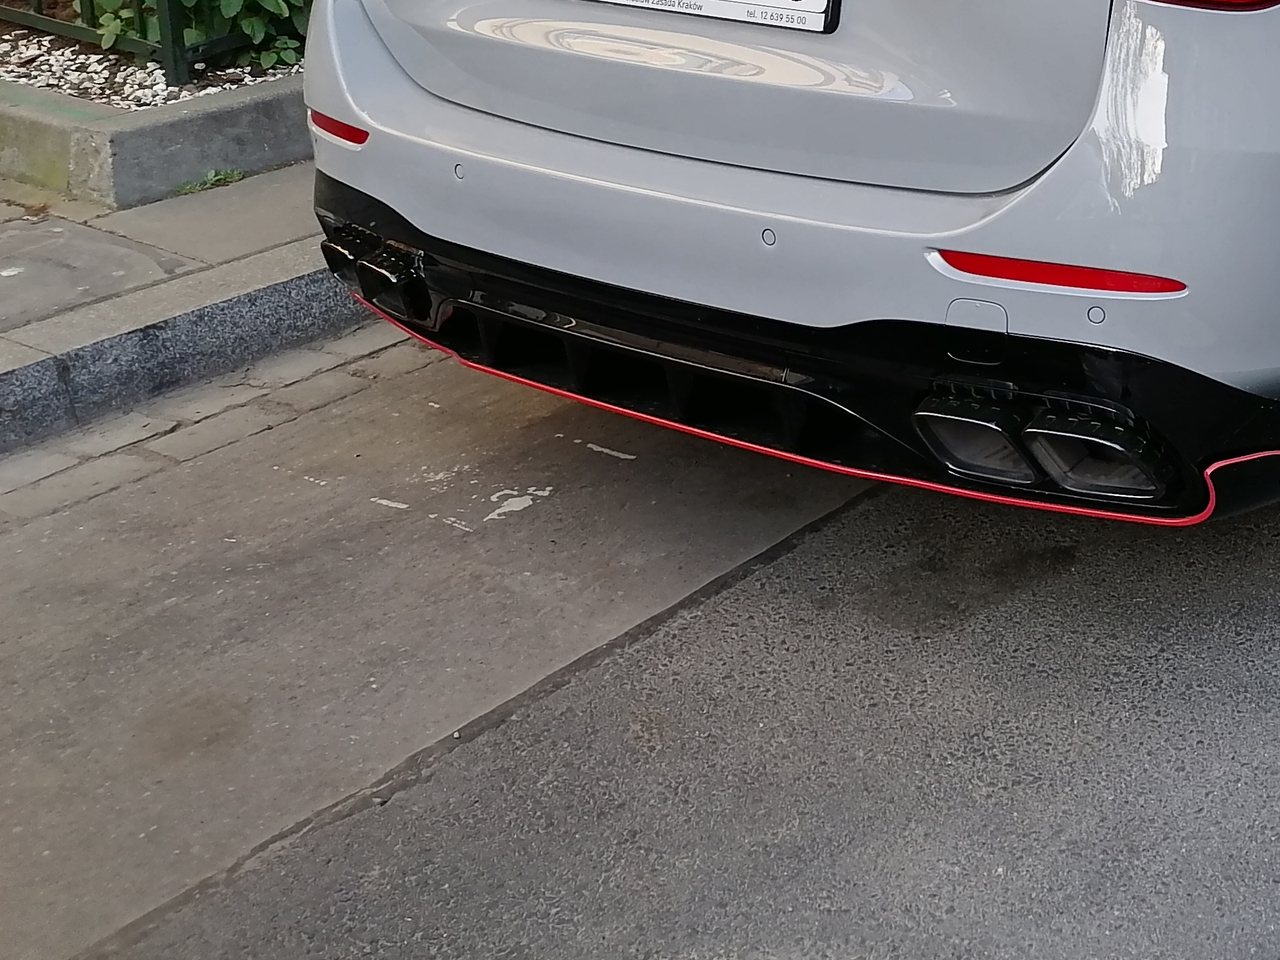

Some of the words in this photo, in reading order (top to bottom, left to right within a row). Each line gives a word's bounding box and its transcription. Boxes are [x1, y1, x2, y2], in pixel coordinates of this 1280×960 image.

[677, 0, 704, 11] Kraków
[746, 9, 758, 19] tel.
[760, 10, 768, 20] 12
[769, 12, 784, 23] 639
[785, 14, 795, 24] 55
[796, 16, 807, 25] 00
